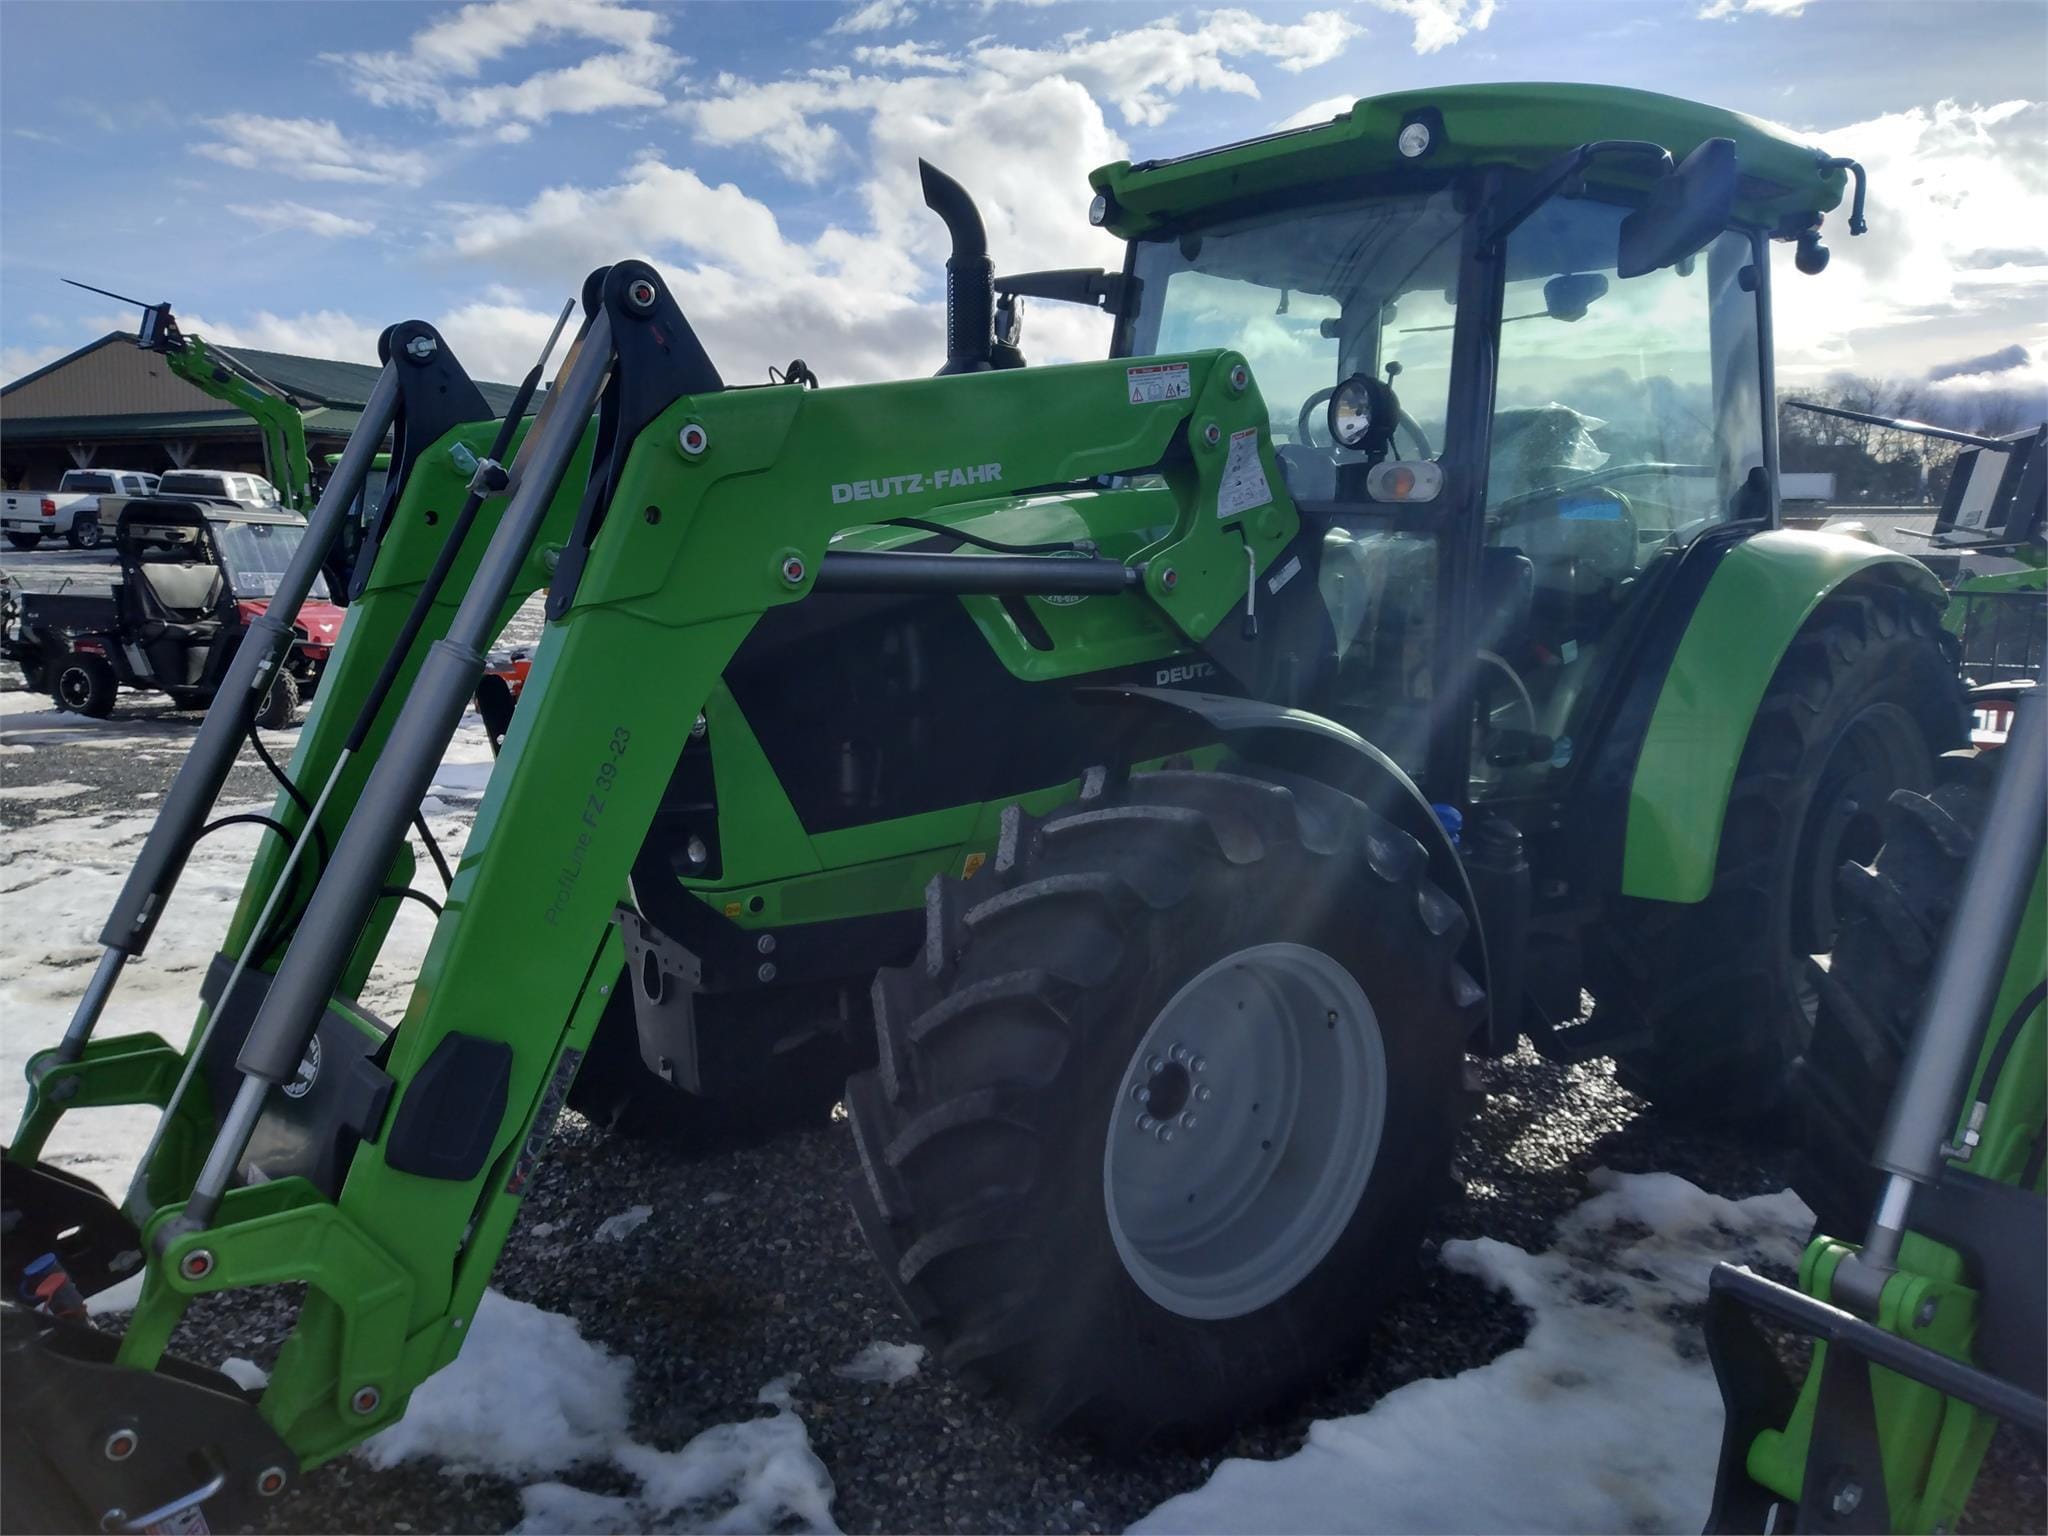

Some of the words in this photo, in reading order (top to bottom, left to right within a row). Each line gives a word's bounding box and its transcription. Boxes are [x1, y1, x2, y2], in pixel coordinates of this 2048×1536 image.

[831, 463, 1002, 504] DEUTZ-FAHR
[582, 793, 605, 828] FZ
[596, 726, 631, 792] 39-23
